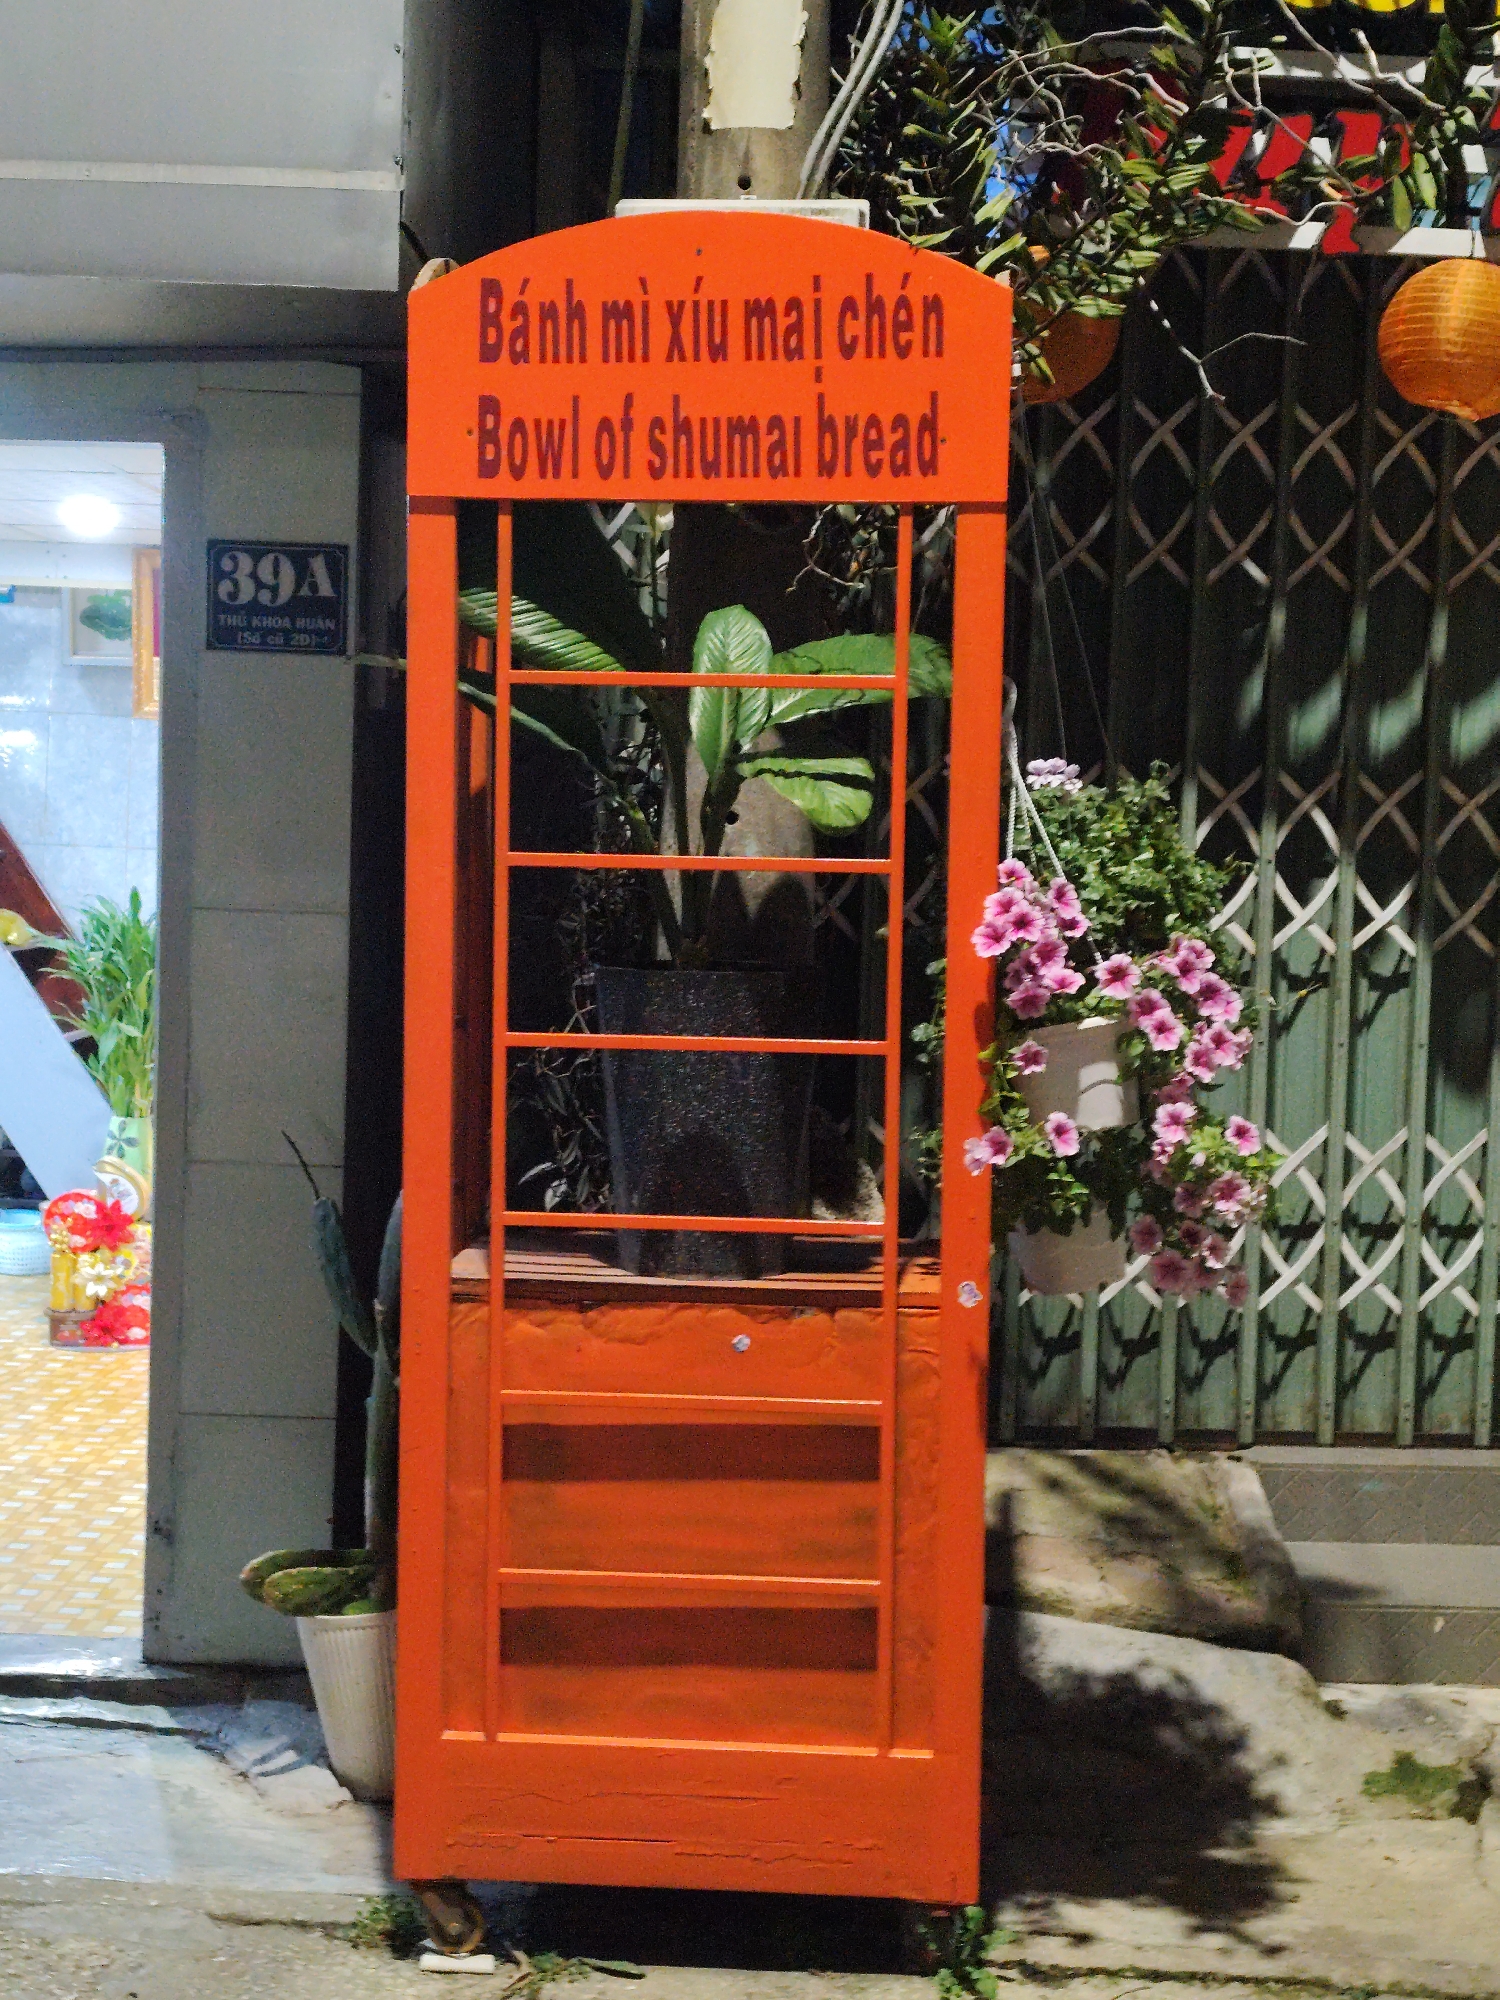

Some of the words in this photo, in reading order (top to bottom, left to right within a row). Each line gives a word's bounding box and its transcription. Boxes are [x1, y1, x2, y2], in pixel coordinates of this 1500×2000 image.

[479, 276, 588, 366] Bánh
[664, 275, 729, 364] xíu
[837, 271, 945, 361] chén
[477, 394, 580, 481] Bowl
[594, 392, 634, 481] of
[817, 390, 939, 479] bread
[217, 550, 339, 607] 39A
[251, 614, 293, 630] KHOA
